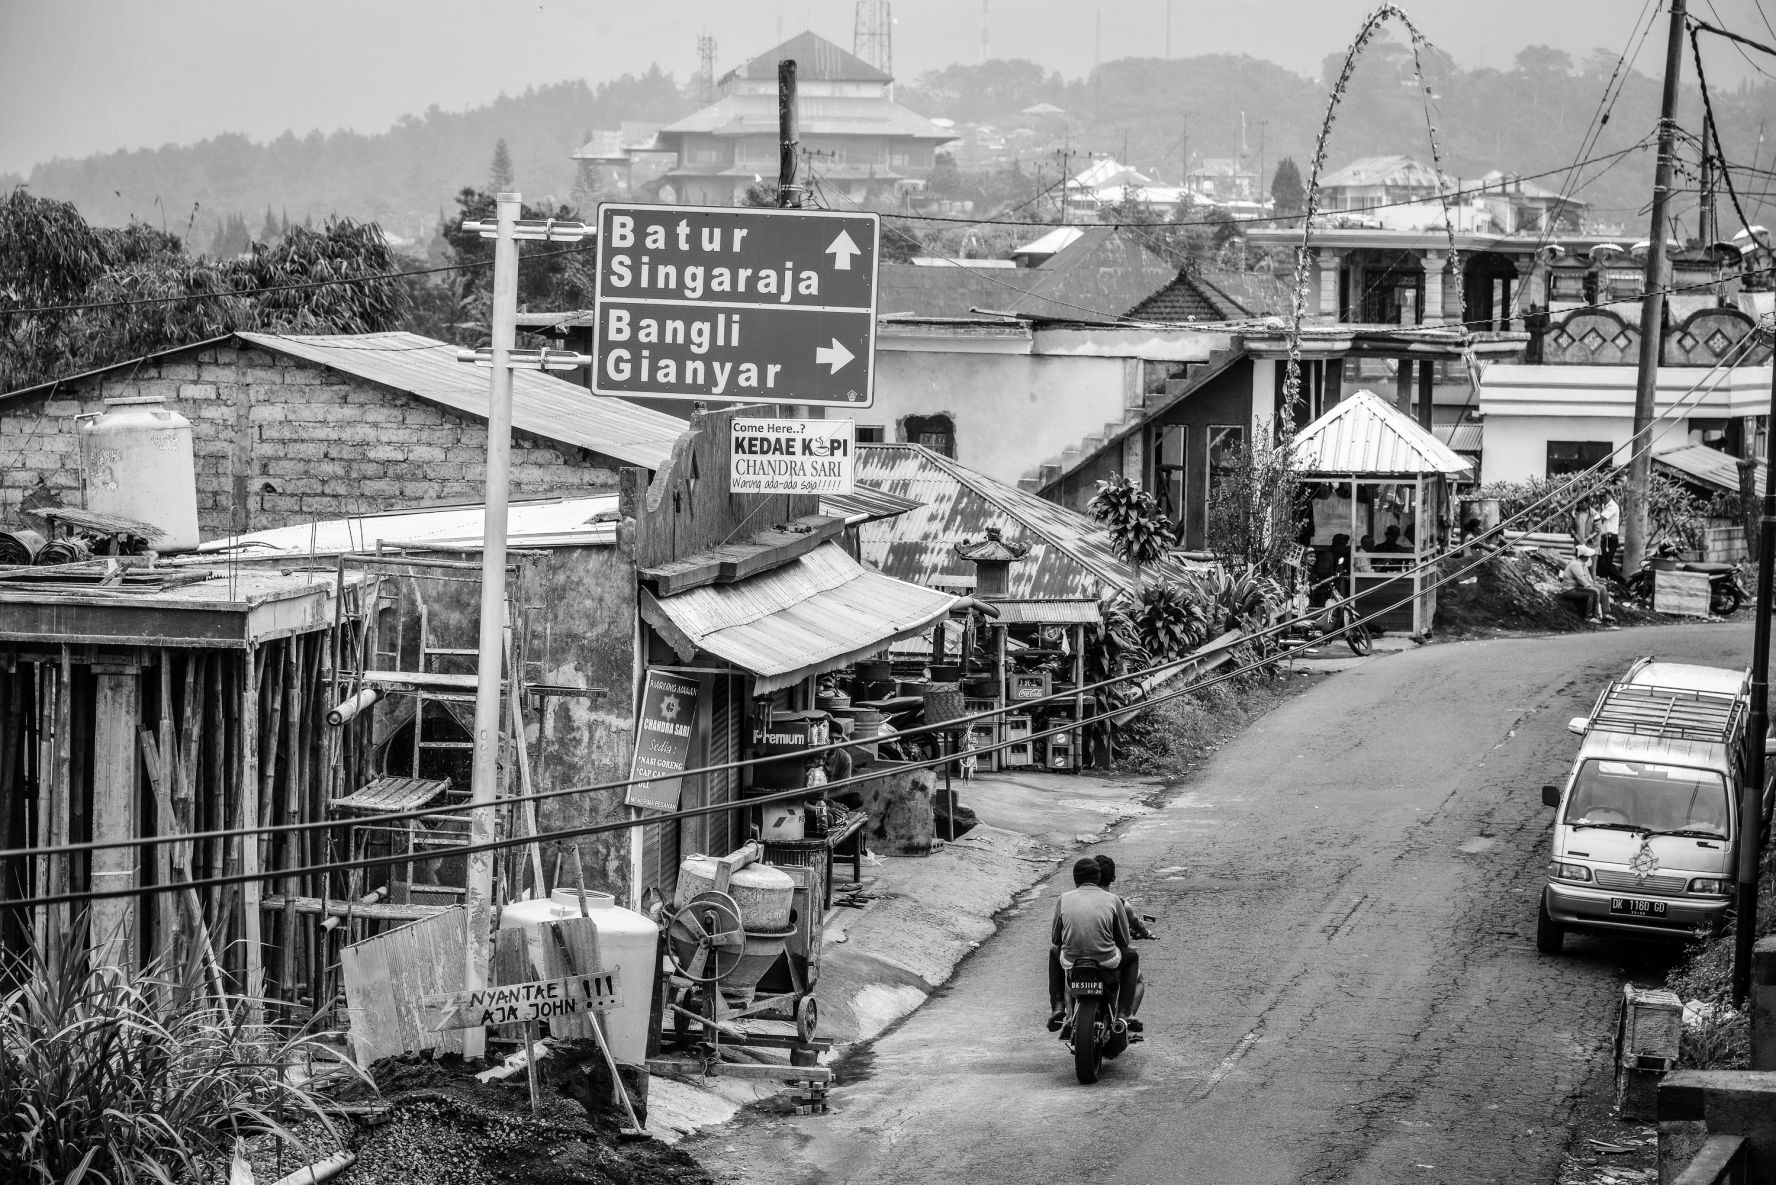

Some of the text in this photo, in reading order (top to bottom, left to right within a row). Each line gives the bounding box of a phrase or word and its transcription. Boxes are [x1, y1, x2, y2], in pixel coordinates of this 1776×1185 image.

[611, 215, 748, 253] Batur
[609, 254, 820, 303] Singaraja
[607, 308, 741, 354] Bangli
[606, 348, 782, 394] Gianyar
[733, 422, 806, 434] Come Here..?
[734, 436, 848, 457] KEDAE KPI
[735, 458, 842, 478] CHANDRA SARI
[643, 718, 690, 738] CHANDRA SARI
[753, 729, 805, 745] Premium
[657, 759, 684, 771] GORENG
[1612, 898, 1623, 909] DK
[1630, 900, 1650, 911] 1160
[1654, 902, 1665, 913] GD
[468, 982, 558, 1008] NYANTAE
[480, 999, 576, 1026] AJA JOHN
